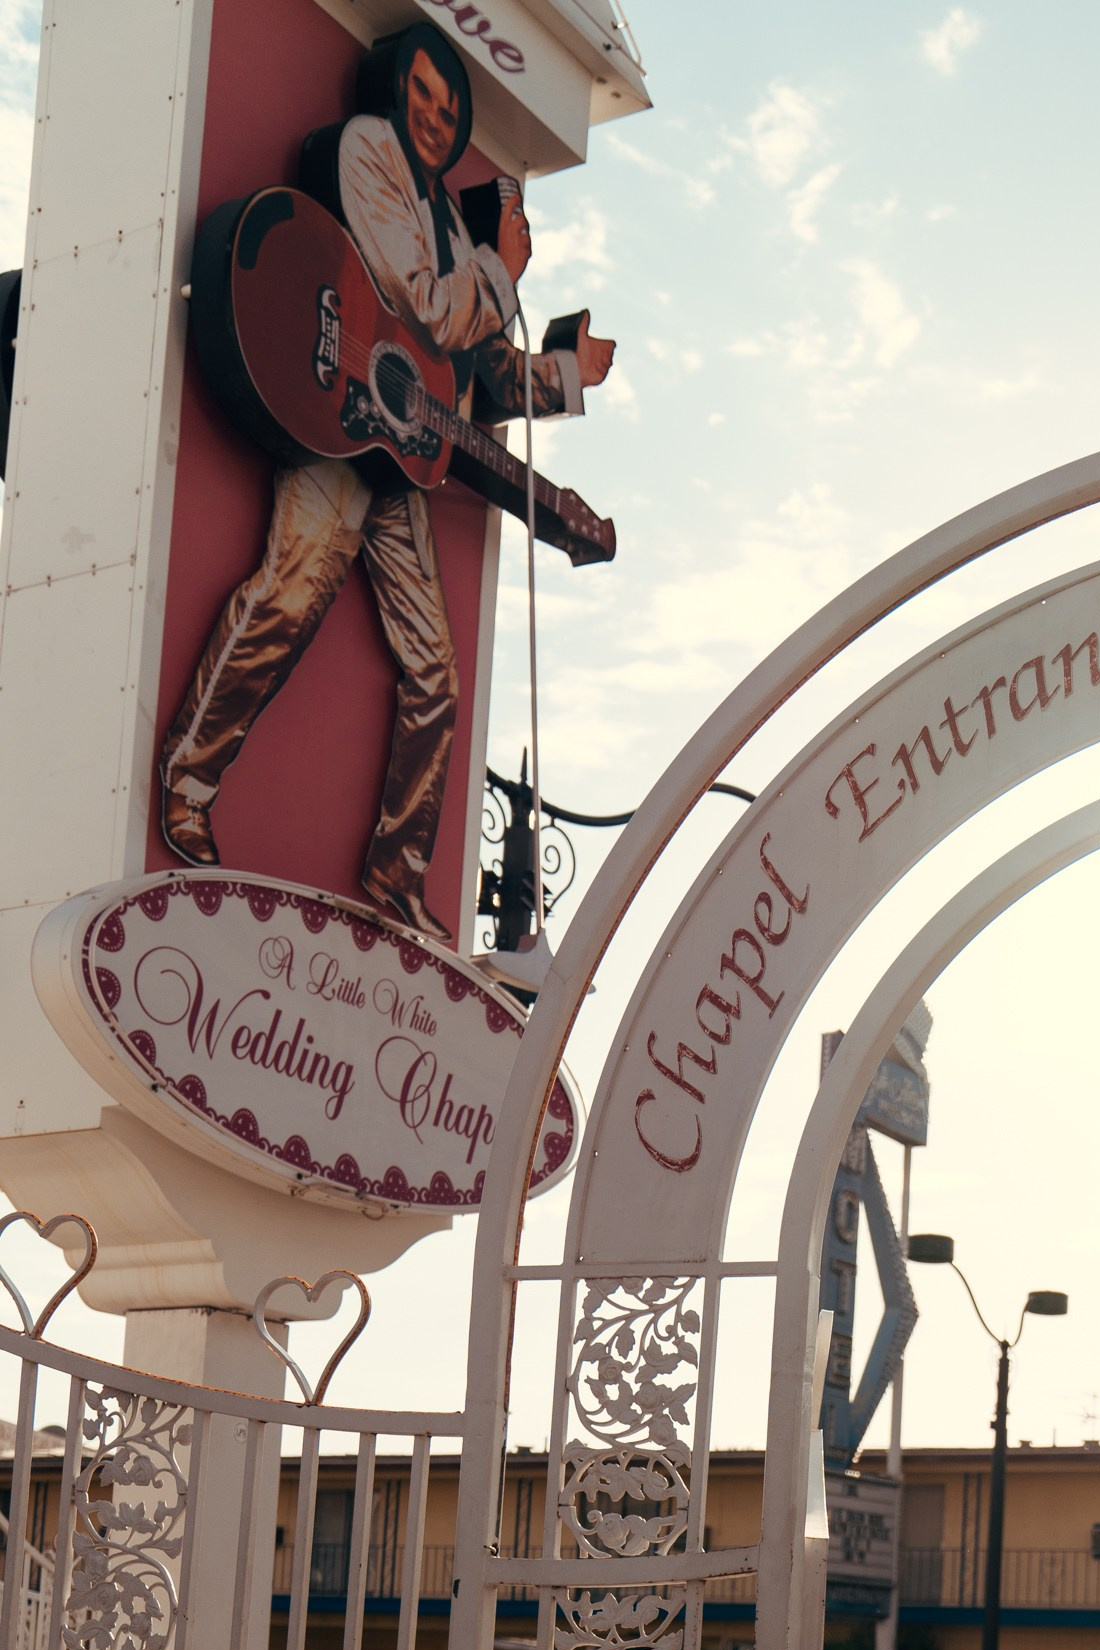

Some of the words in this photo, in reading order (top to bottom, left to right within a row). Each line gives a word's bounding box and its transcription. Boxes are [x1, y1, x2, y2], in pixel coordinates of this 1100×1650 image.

[428, 0, 525, 73] ve
[134, 946, 355, 1121] Wedding
[375, 1036, 496, 1165] Chap
[259, 936, 296, 990] A
[306, 952, 366, 1009] Little
[373, 979, 437, 1037] White
[635, 832, 811, 1173] Chapel
